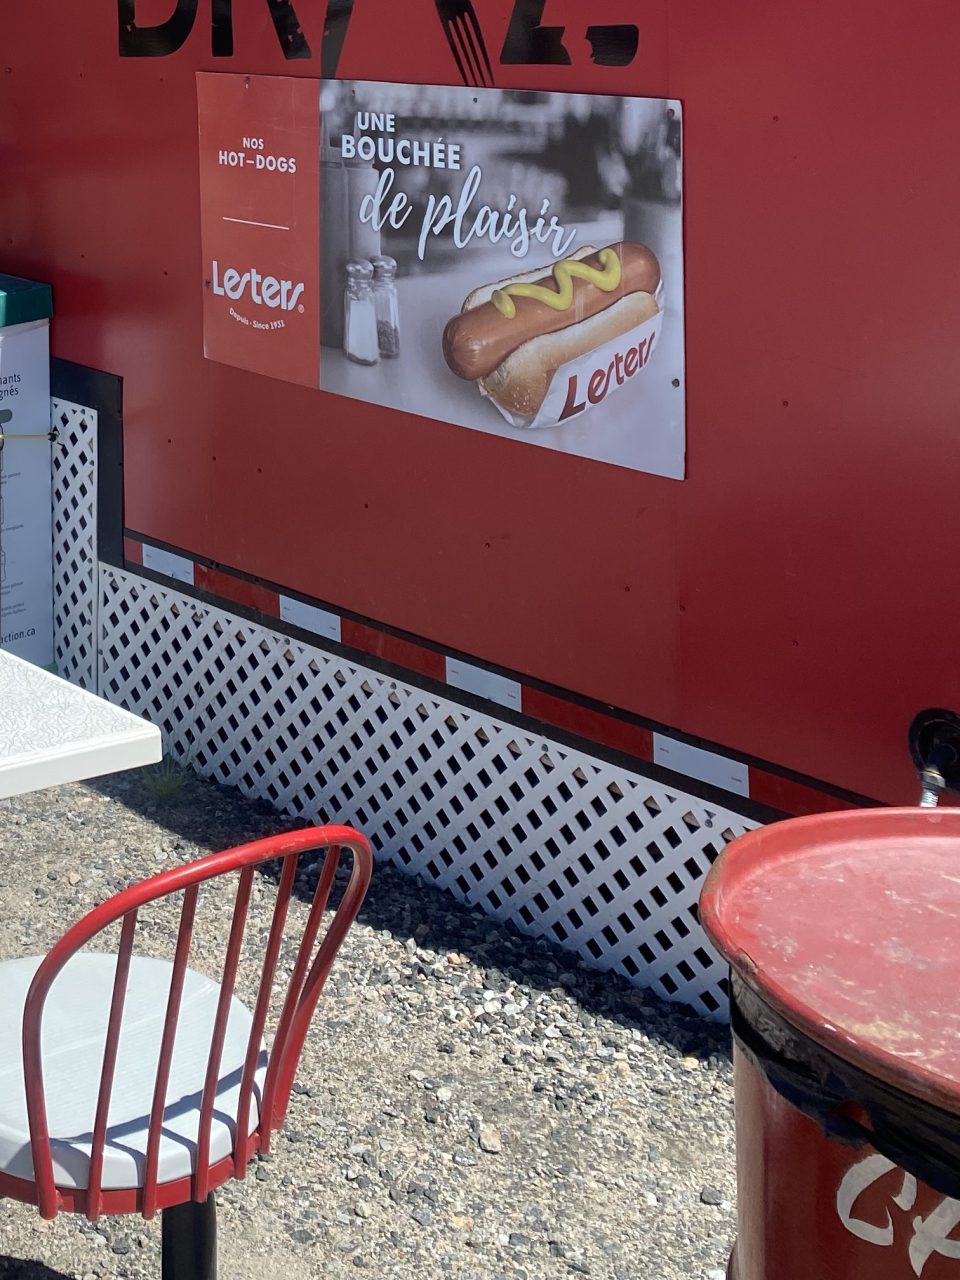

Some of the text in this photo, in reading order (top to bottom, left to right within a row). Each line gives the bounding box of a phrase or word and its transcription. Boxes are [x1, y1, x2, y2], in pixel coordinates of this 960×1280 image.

[357, 111, 395, 132] UNE
[242, 137, 264, 150] NOS
[341, 137, 460, 170] BOUCHÉE
[218, 150, 297, 173] HOT-DOGS
[359, 165, 577, 261] de plaisir
